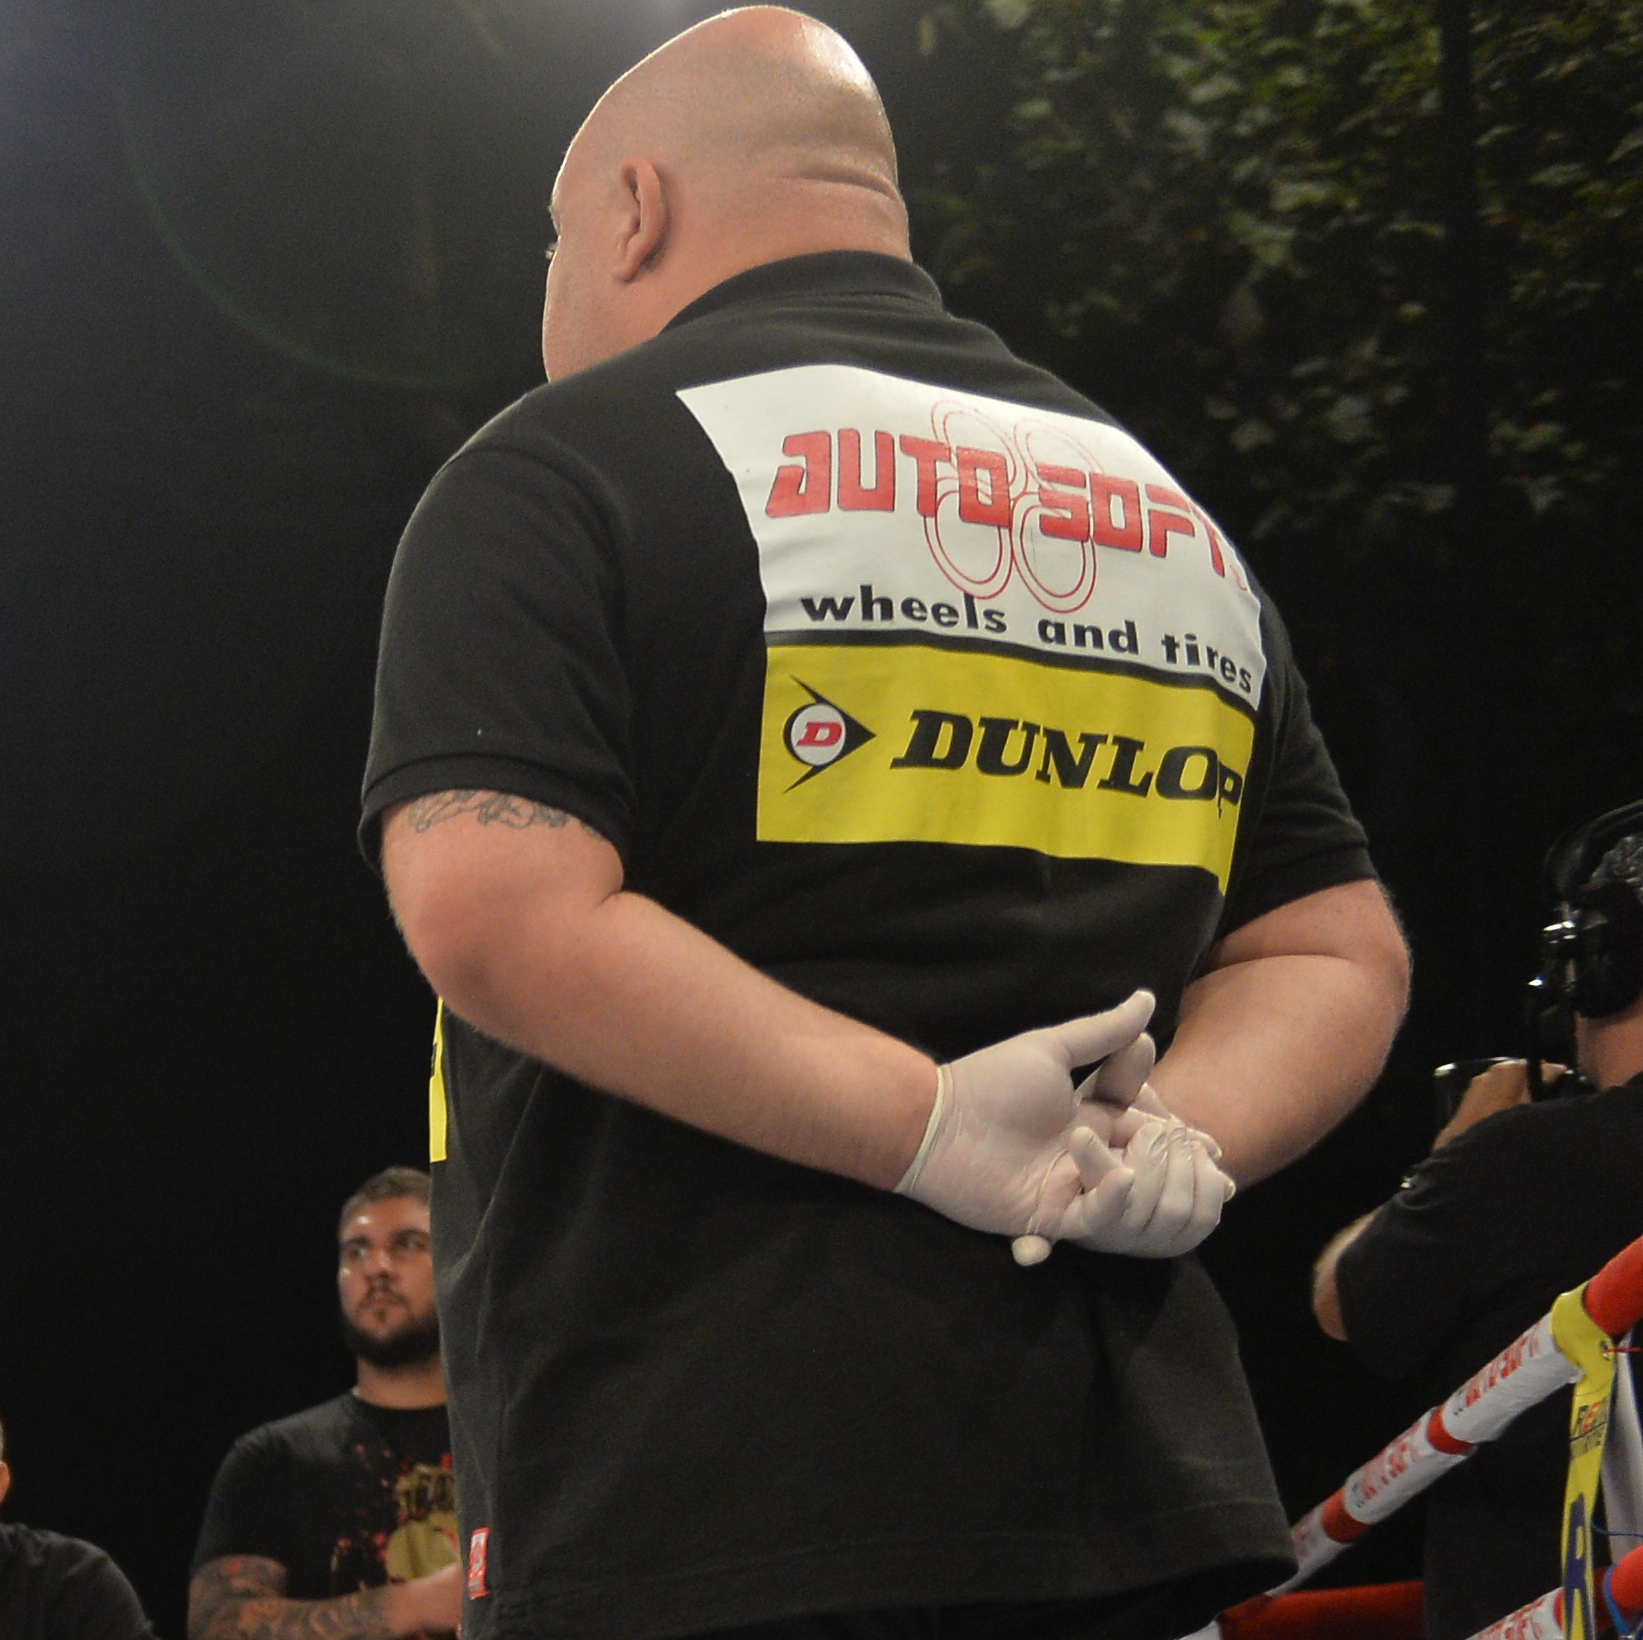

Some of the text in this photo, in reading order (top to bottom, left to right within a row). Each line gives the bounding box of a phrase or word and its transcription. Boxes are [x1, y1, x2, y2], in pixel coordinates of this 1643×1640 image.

[765, 427, 1013, 529] AUTO
[801, 585, 1253, 695] wheels and tires
[890, 709, 1242, 819] DUNLOP
